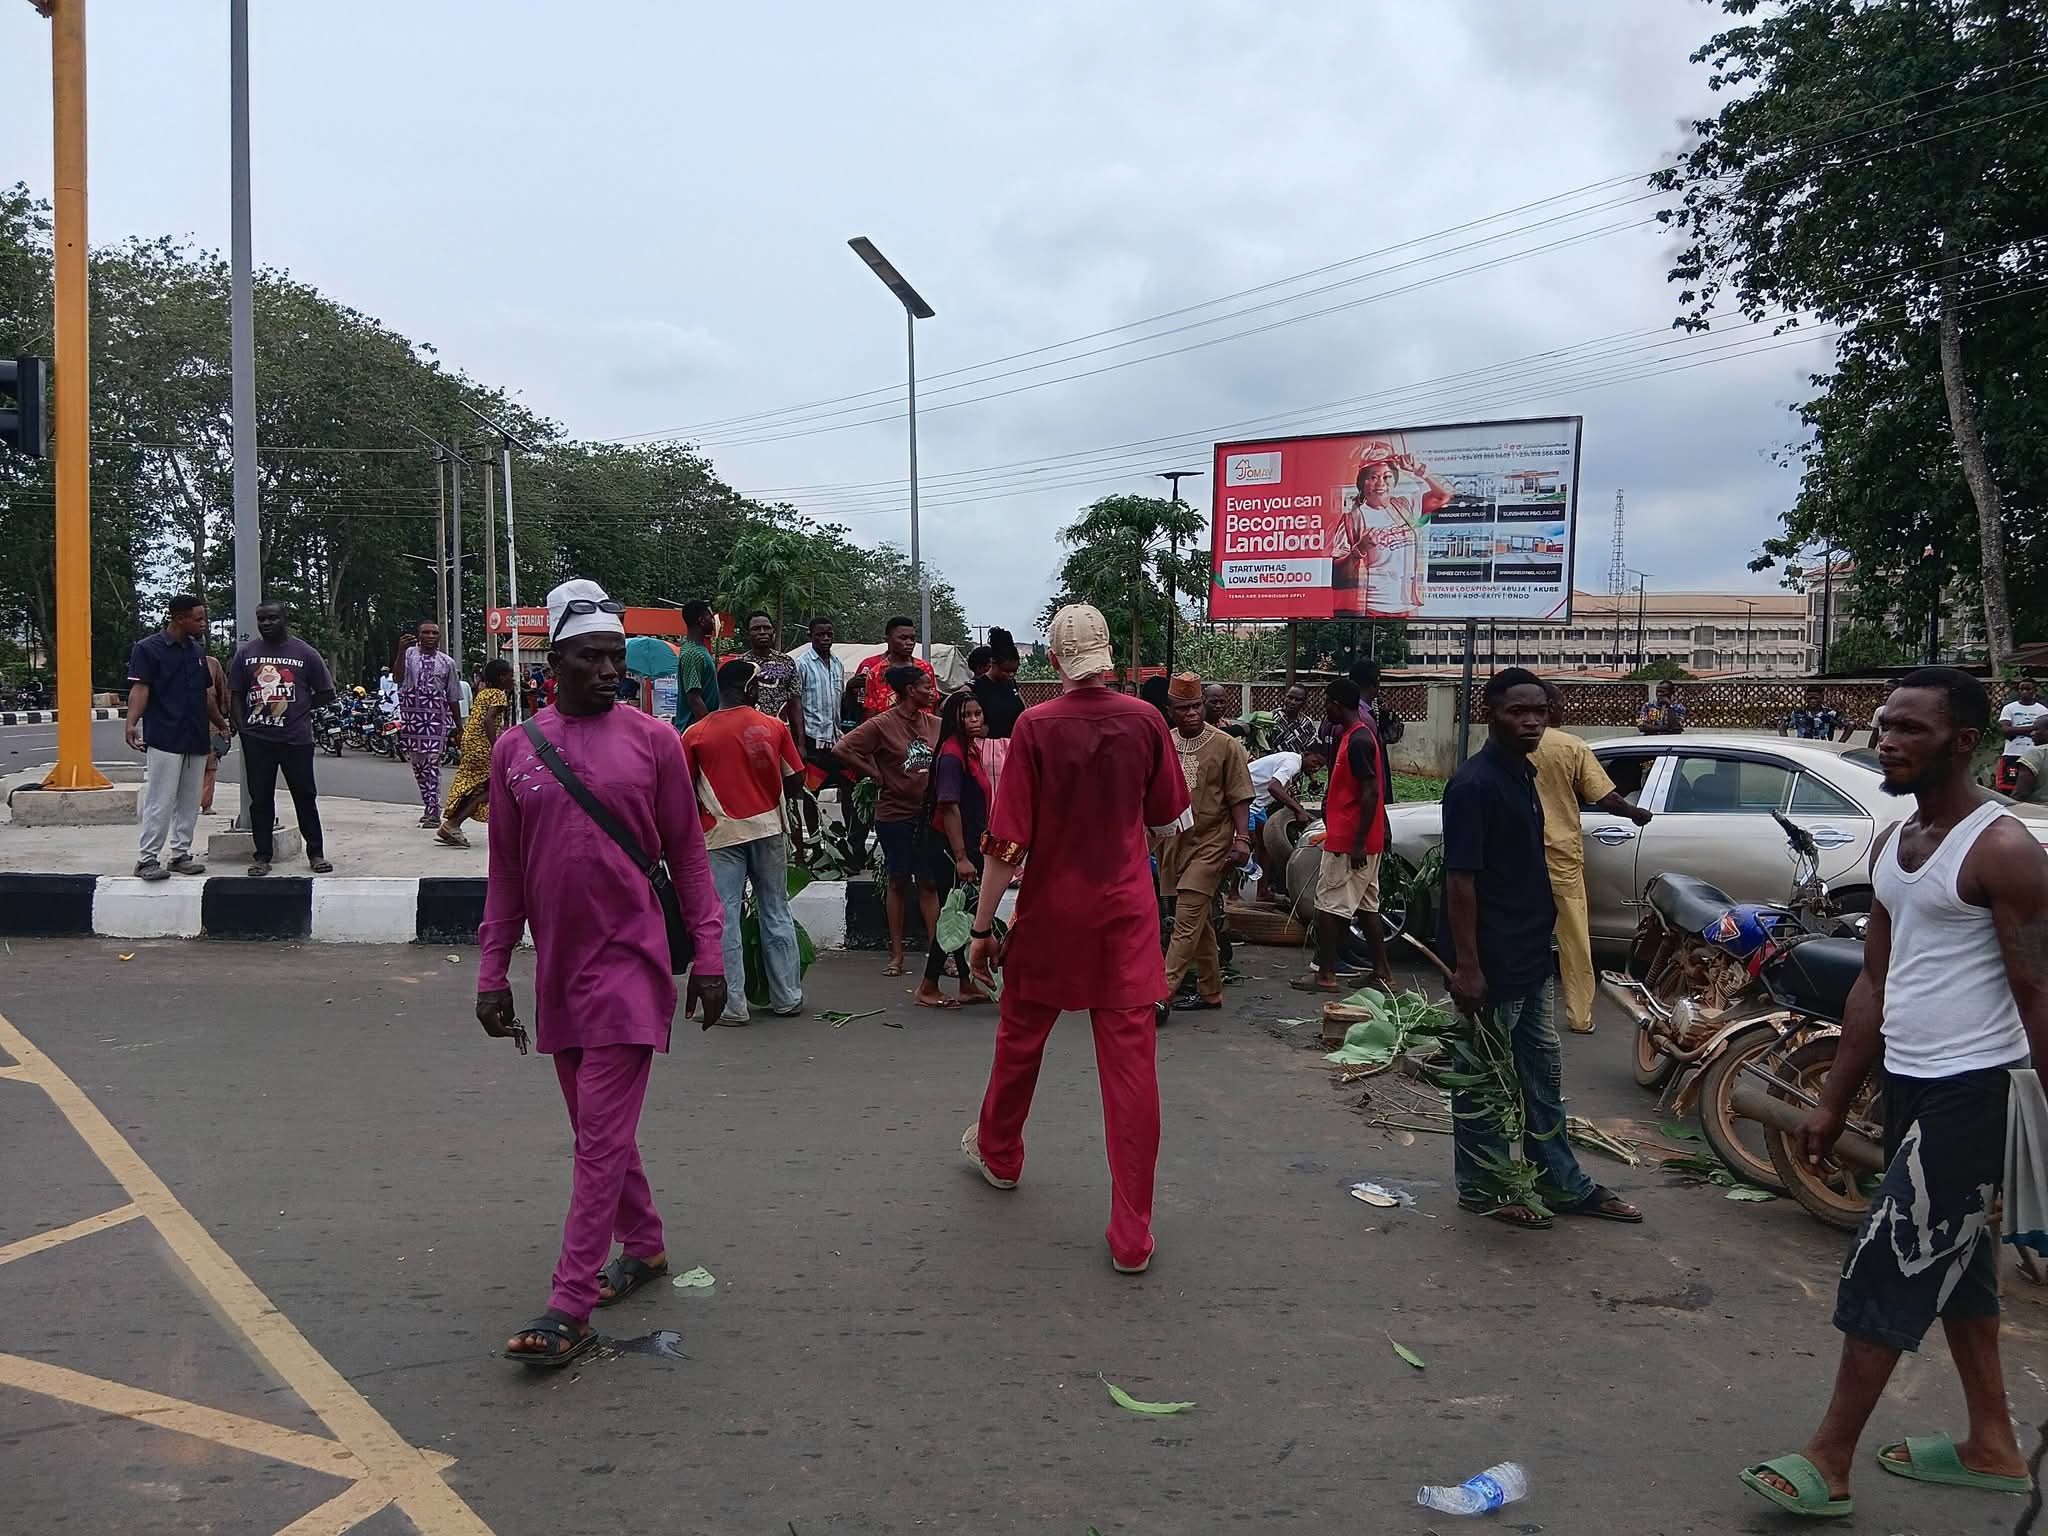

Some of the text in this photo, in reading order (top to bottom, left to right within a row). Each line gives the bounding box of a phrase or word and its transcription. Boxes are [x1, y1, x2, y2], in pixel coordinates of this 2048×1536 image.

[1226, 495, 1322, 513] Even you can
[1226, 514, 1322, 533] Become a
[1225, 529, 1325, 553] Landlord
[1228, 565, 1254, 573] START
[1276, 564, 1287, 572] AS
[1228, 576, 1247, 584] LOW
[245, 657, 304, 668] I'M BRINGING
